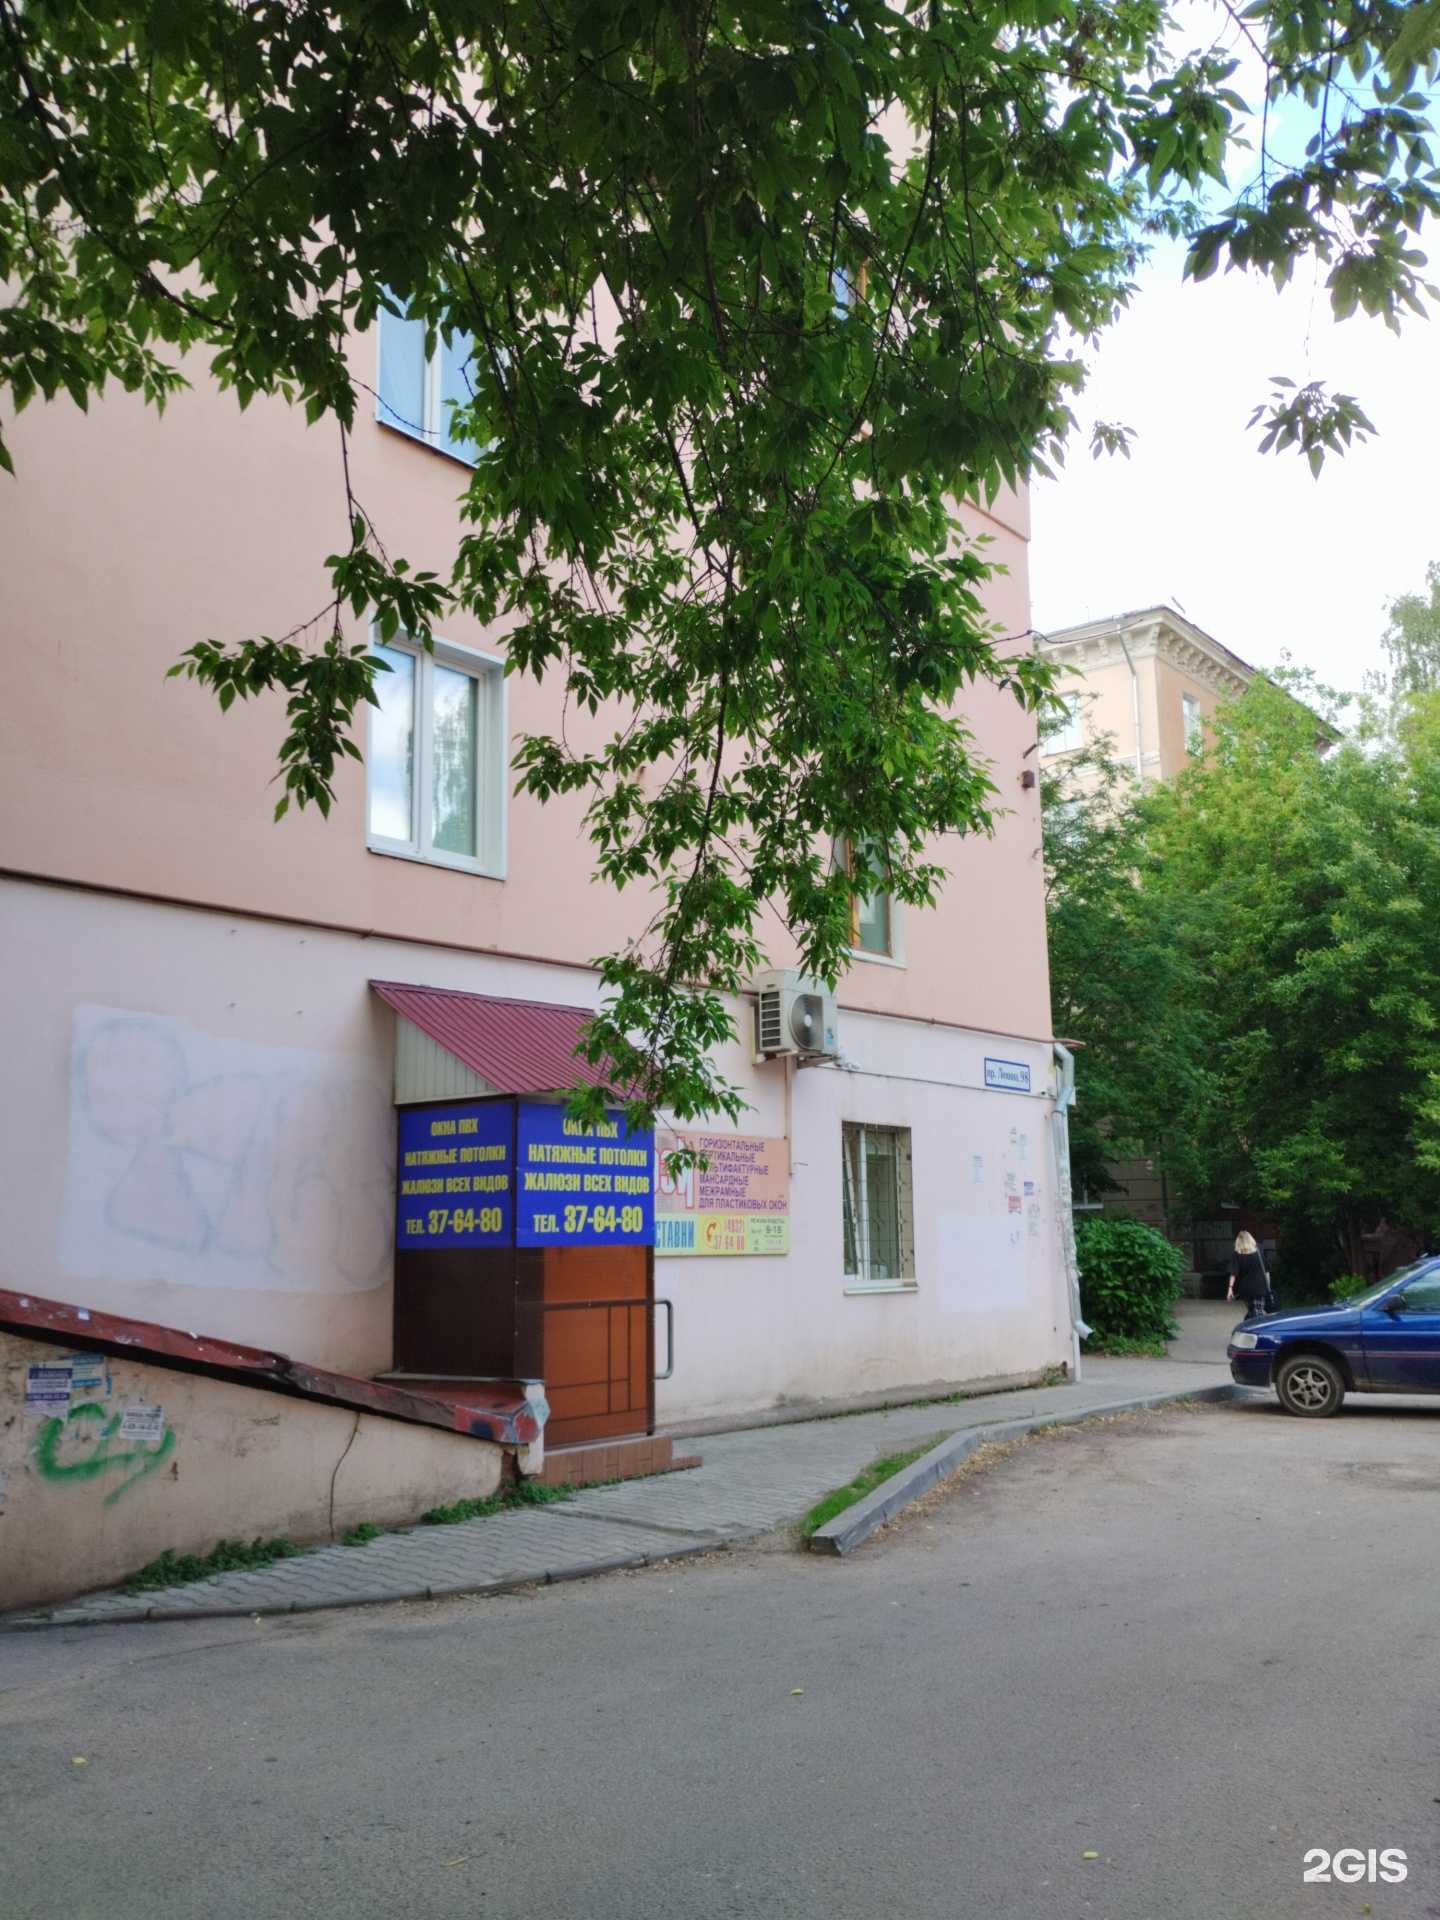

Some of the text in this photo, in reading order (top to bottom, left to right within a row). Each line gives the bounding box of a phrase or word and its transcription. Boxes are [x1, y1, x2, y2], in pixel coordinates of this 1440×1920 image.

[431, 1118, 478, 1136] ОКНА ПВХ
[700, 1137, 765, 1152] ГОРИЗОНТАЛЬНЫЕ
[404, 1145, 506, 1166] НАТЯЖНЫЕ ПОТОЛКИ
[528, 1144, 647, 1166] НАТЯЖНЫЕ ПОТОЛКИ
[700, 1150, 756, 1163] РТИКАЛЬНЫЕ
[402, 1175, 508, 1195] ЖАЛЮЗИ ВСЕХ ВИДОВ
[524, 1172, 649, 1195] ЖАЛЮЗИ ВСЕХ ВИДОВ
[699, 1197, 714, 1208] ДЛЯ
[715, 1198, 767, 1209] ПЛАСТИКОВЫХ
[406, 1208, 502, 1234] ТЕЛ. 37-64-80
[533, 1206, 643, 1233] ТЕЛ. 37-64-80
